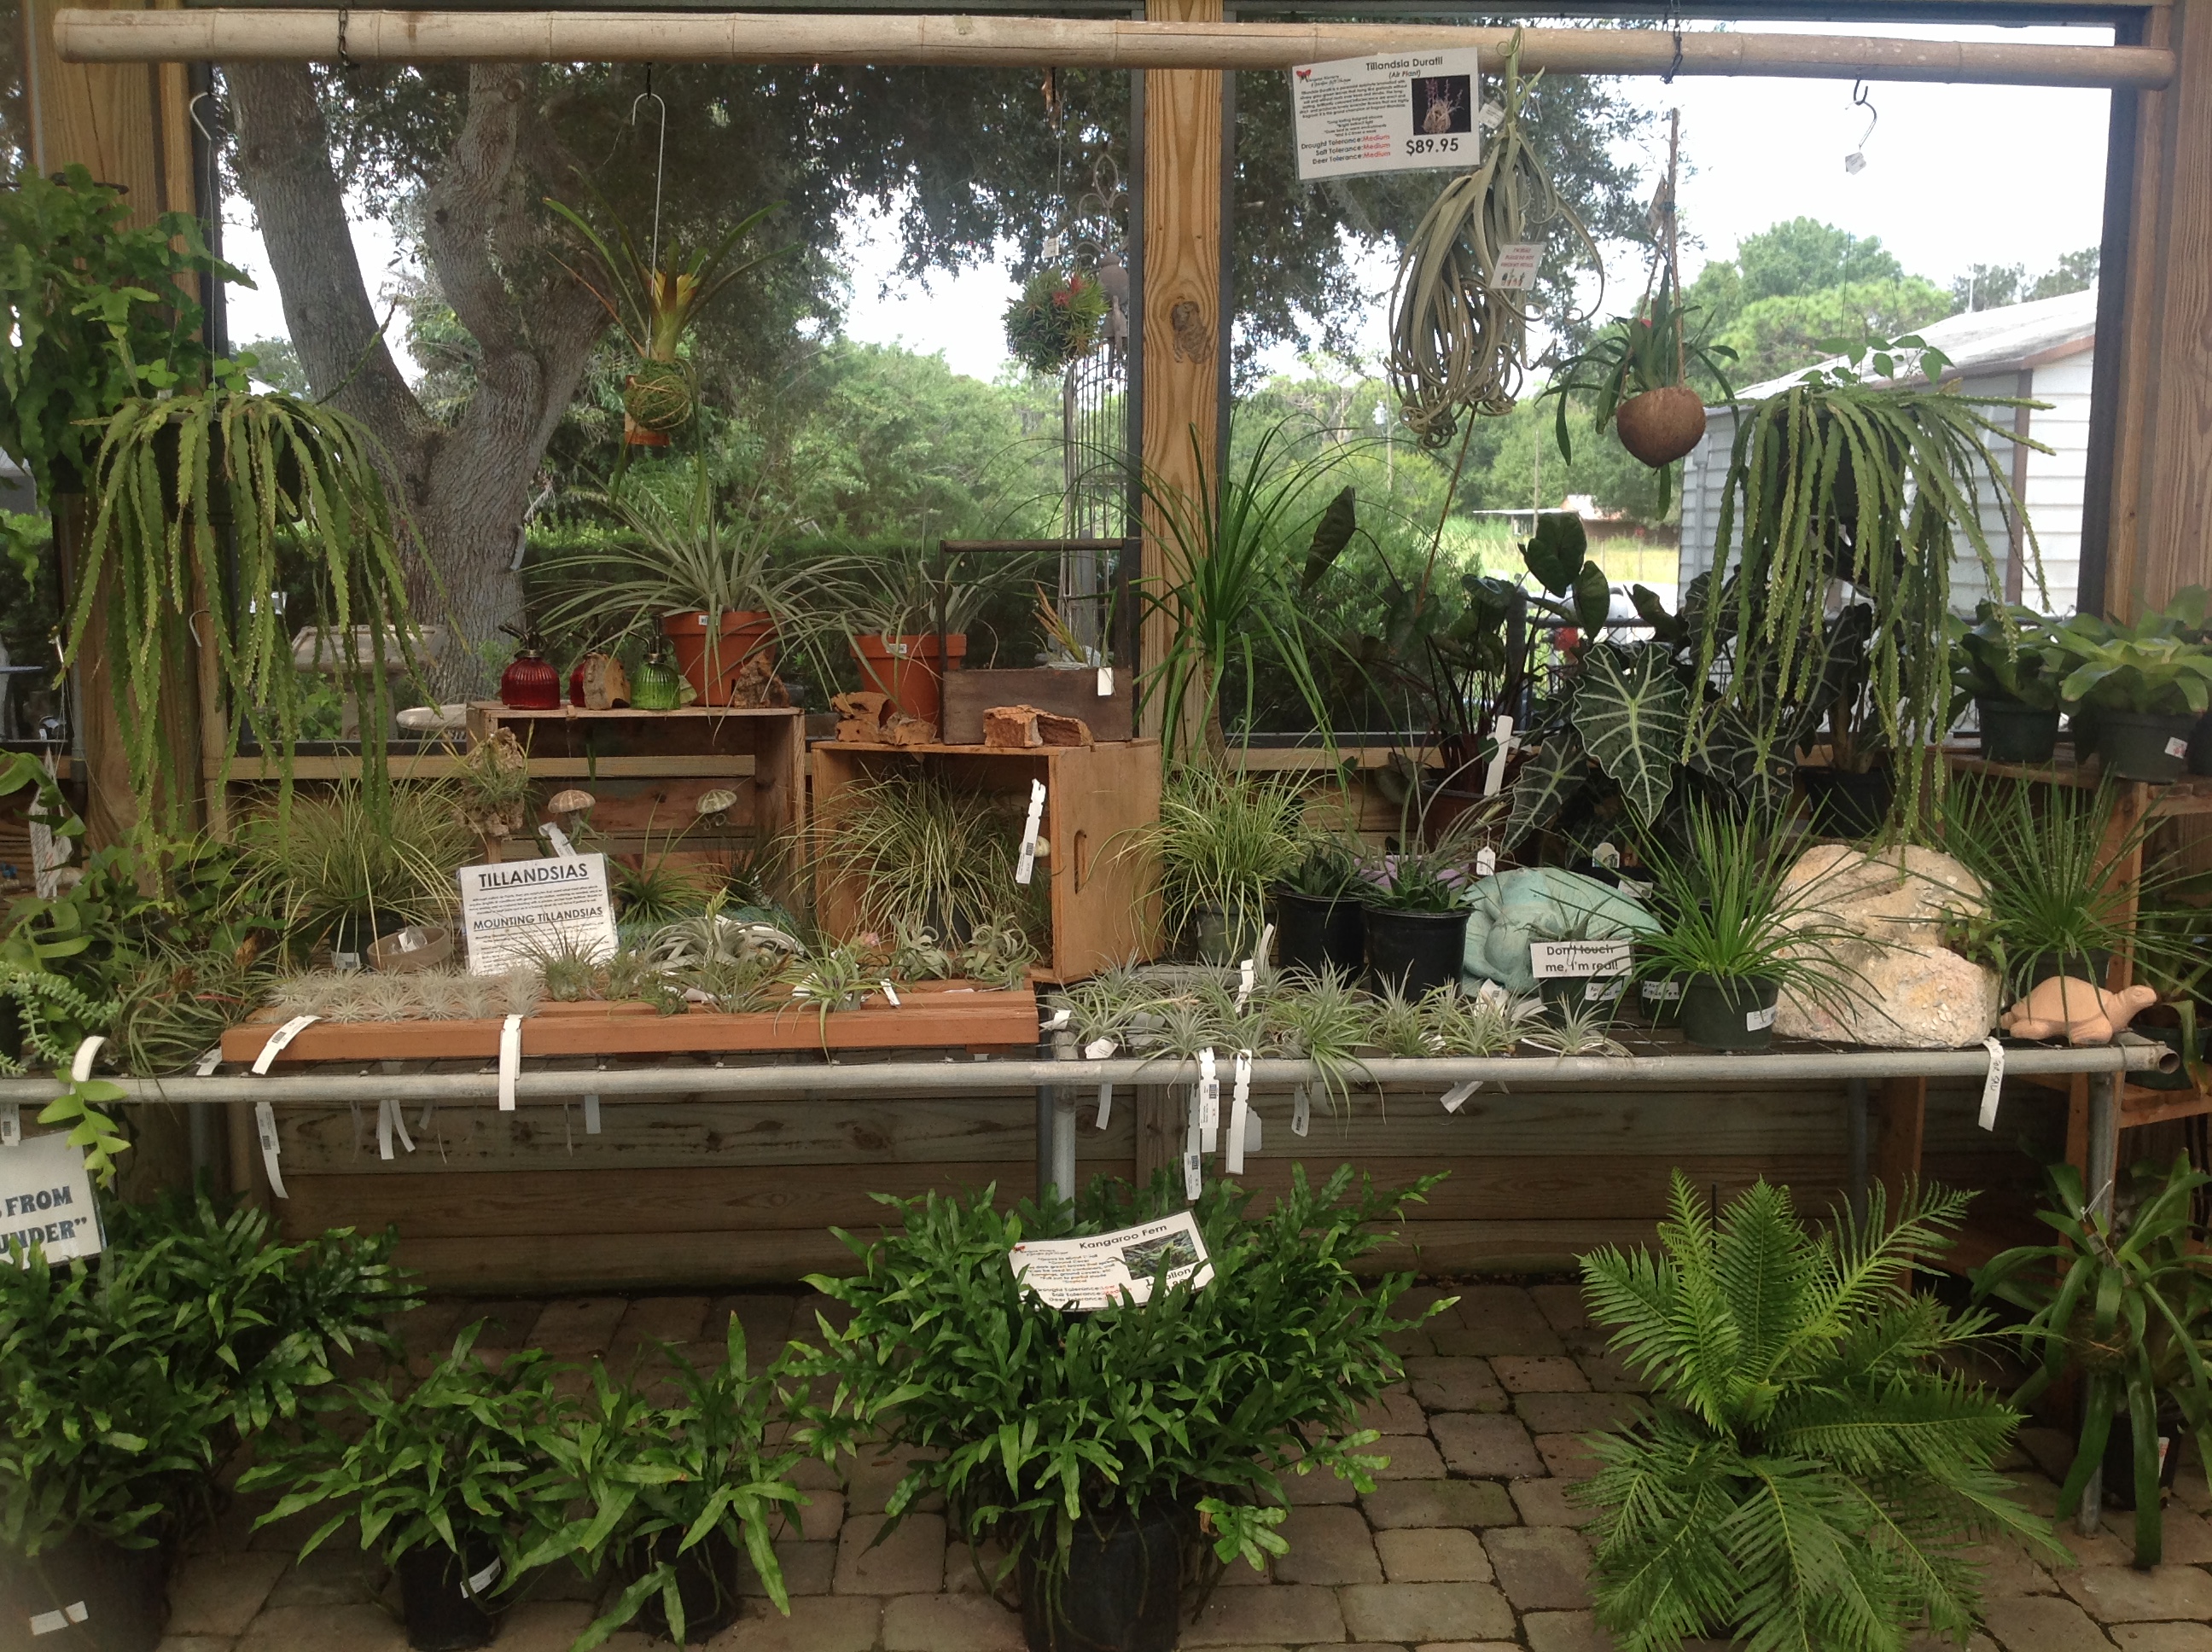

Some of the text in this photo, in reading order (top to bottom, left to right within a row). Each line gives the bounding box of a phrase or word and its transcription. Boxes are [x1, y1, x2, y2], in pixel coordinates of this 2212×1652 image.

[1366, 56, 1443, 72] Tillandsia Duratii
[1406, 137, 1459, 156] $89.95
[478, 863, 589, 888] TILLANDSIAS
[474, 906, 603, 930] MOUNTING TILLANDSIAS
[1546, 943, 1614, 956] Don't touch
[1545, 960, 1618, 973] me, I'm real!
[5, 1185, 73, 1218] FROM
[1079, 1224, 1168, 1250] Kangaroo Fern
